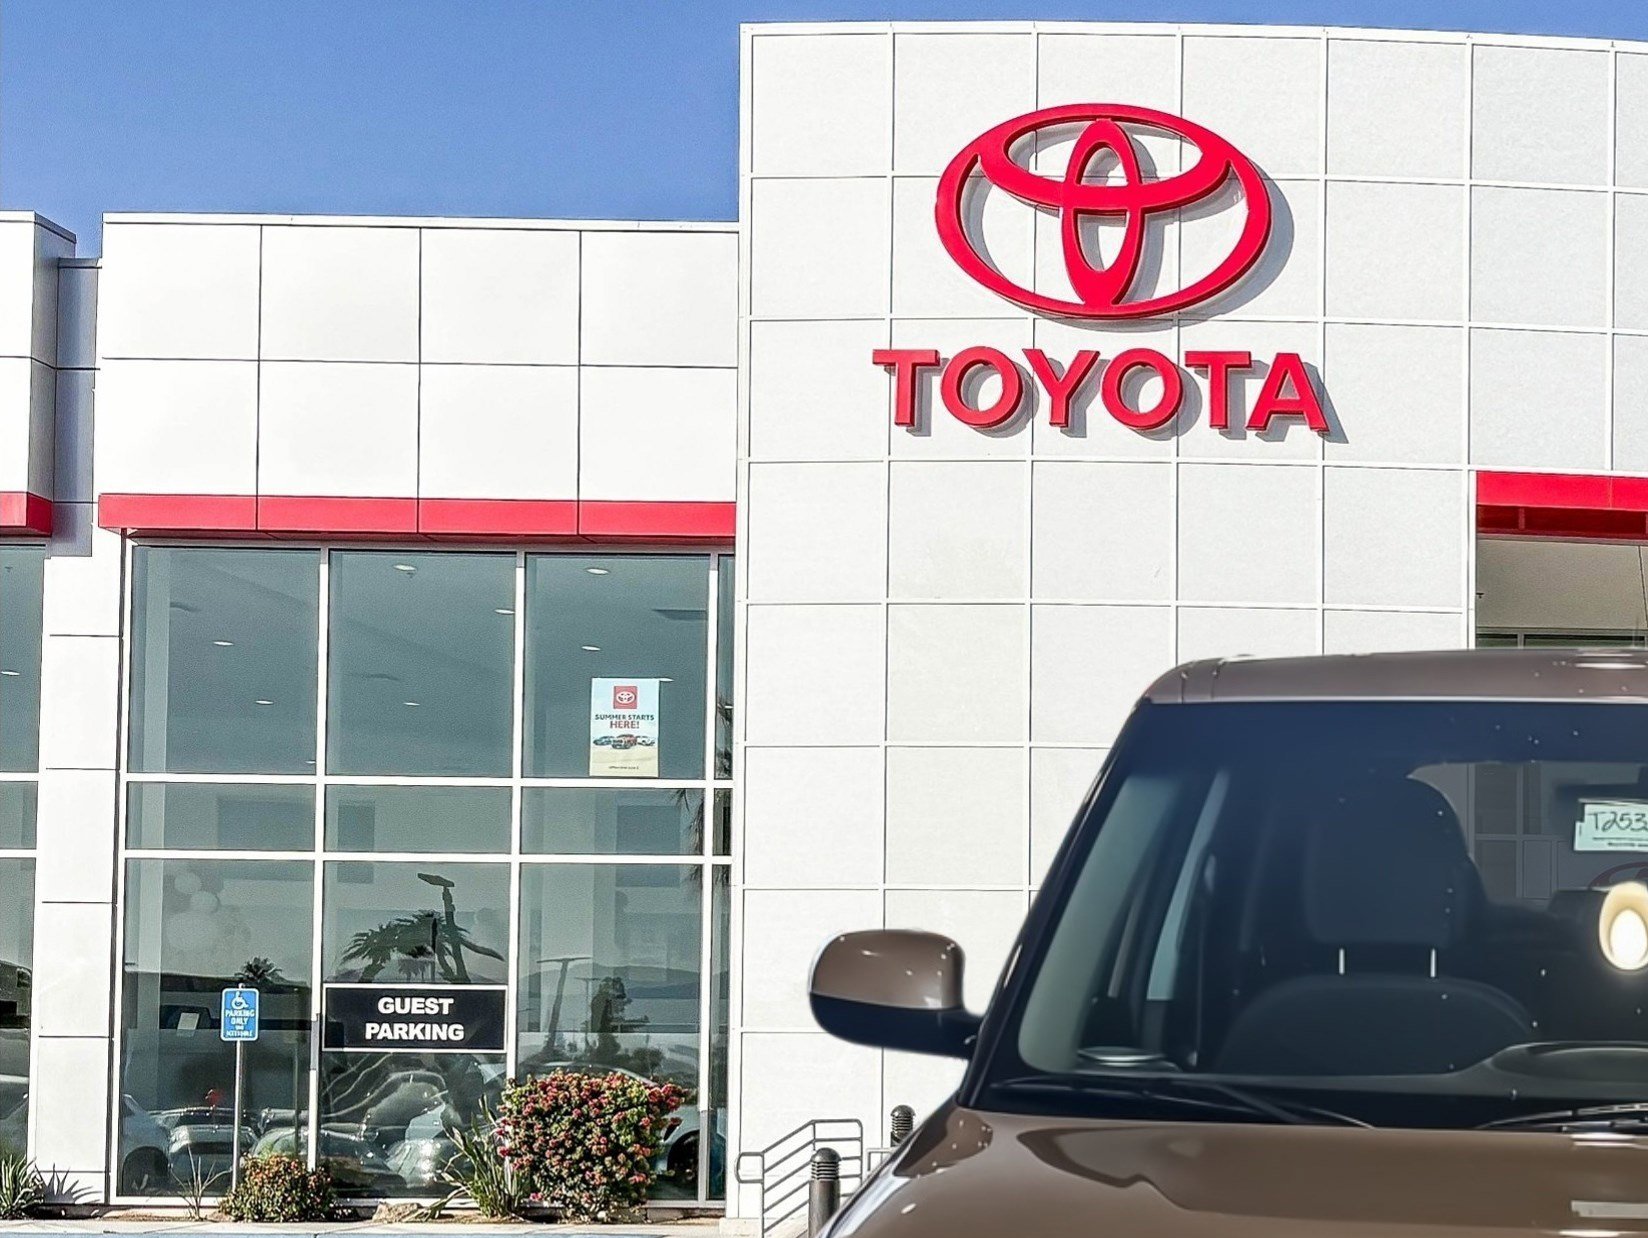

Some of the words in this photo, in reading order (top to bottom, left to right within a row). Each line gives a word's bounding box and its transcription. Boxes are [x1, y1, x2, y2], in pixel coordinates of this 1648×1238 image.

[872, 346, 1331, 434] TOYOTA
[610, 721, 640, 729] HERE!
[378, 997, 454, 1015] GUEST
[365, 1023, 464, 1041] PARKING
